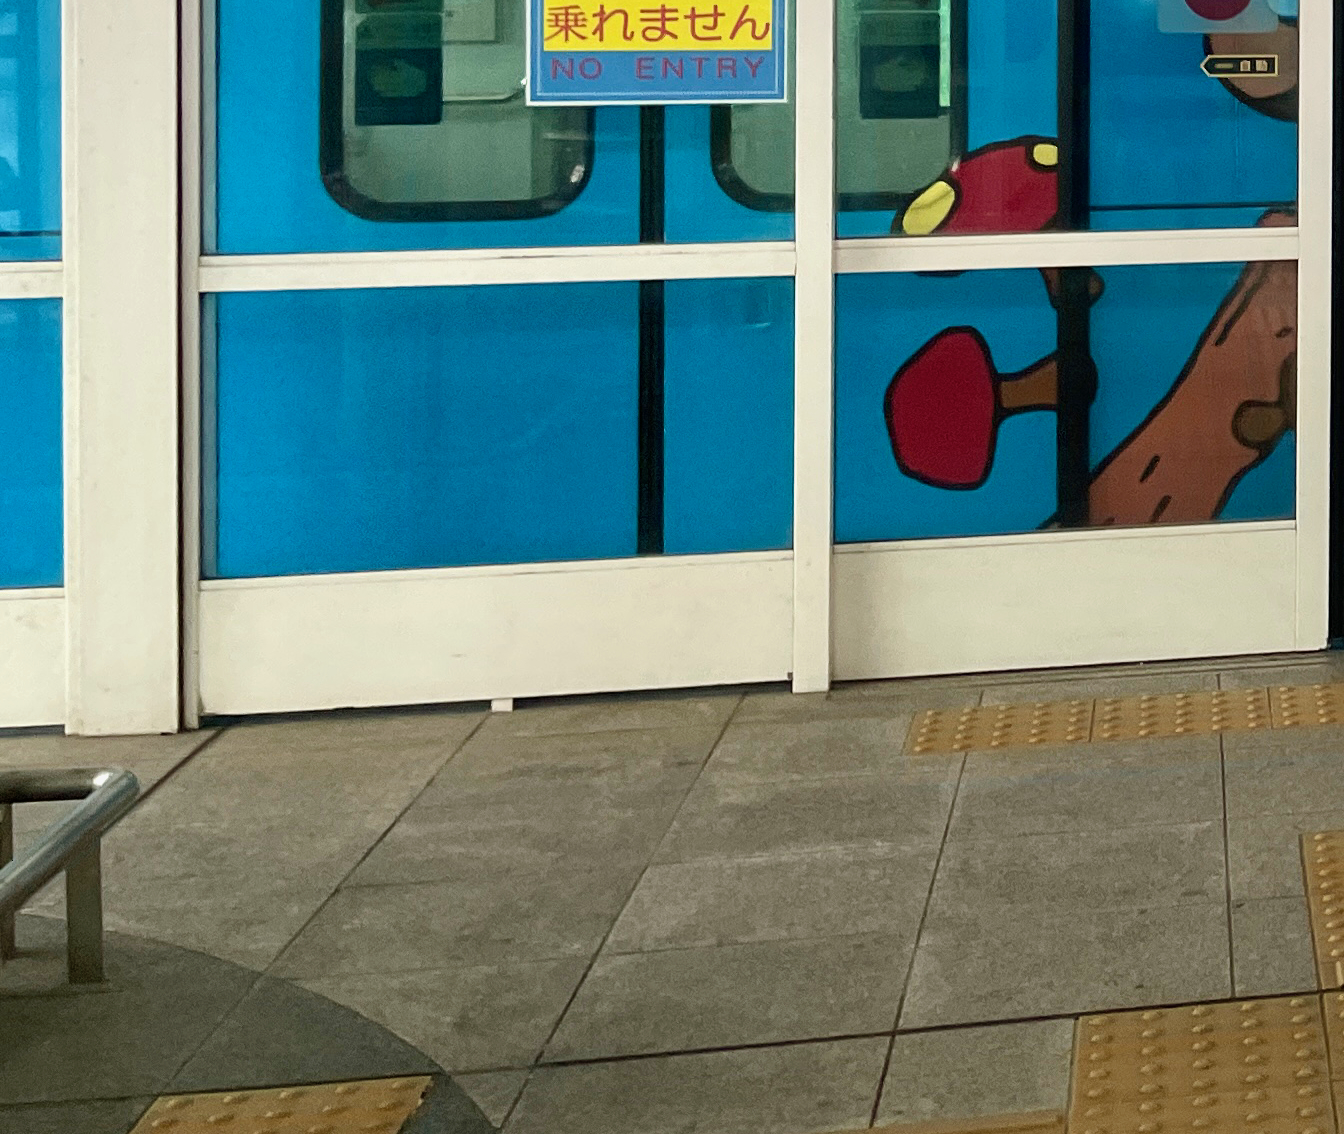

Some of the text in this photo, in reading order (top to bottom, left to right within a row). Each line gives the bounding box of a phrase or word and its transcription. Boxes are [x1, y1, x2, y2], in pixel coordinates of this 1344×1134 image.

[544, 3, 771, 43] 乗れません
[551, 55, 765, 81] NO ENTRY
